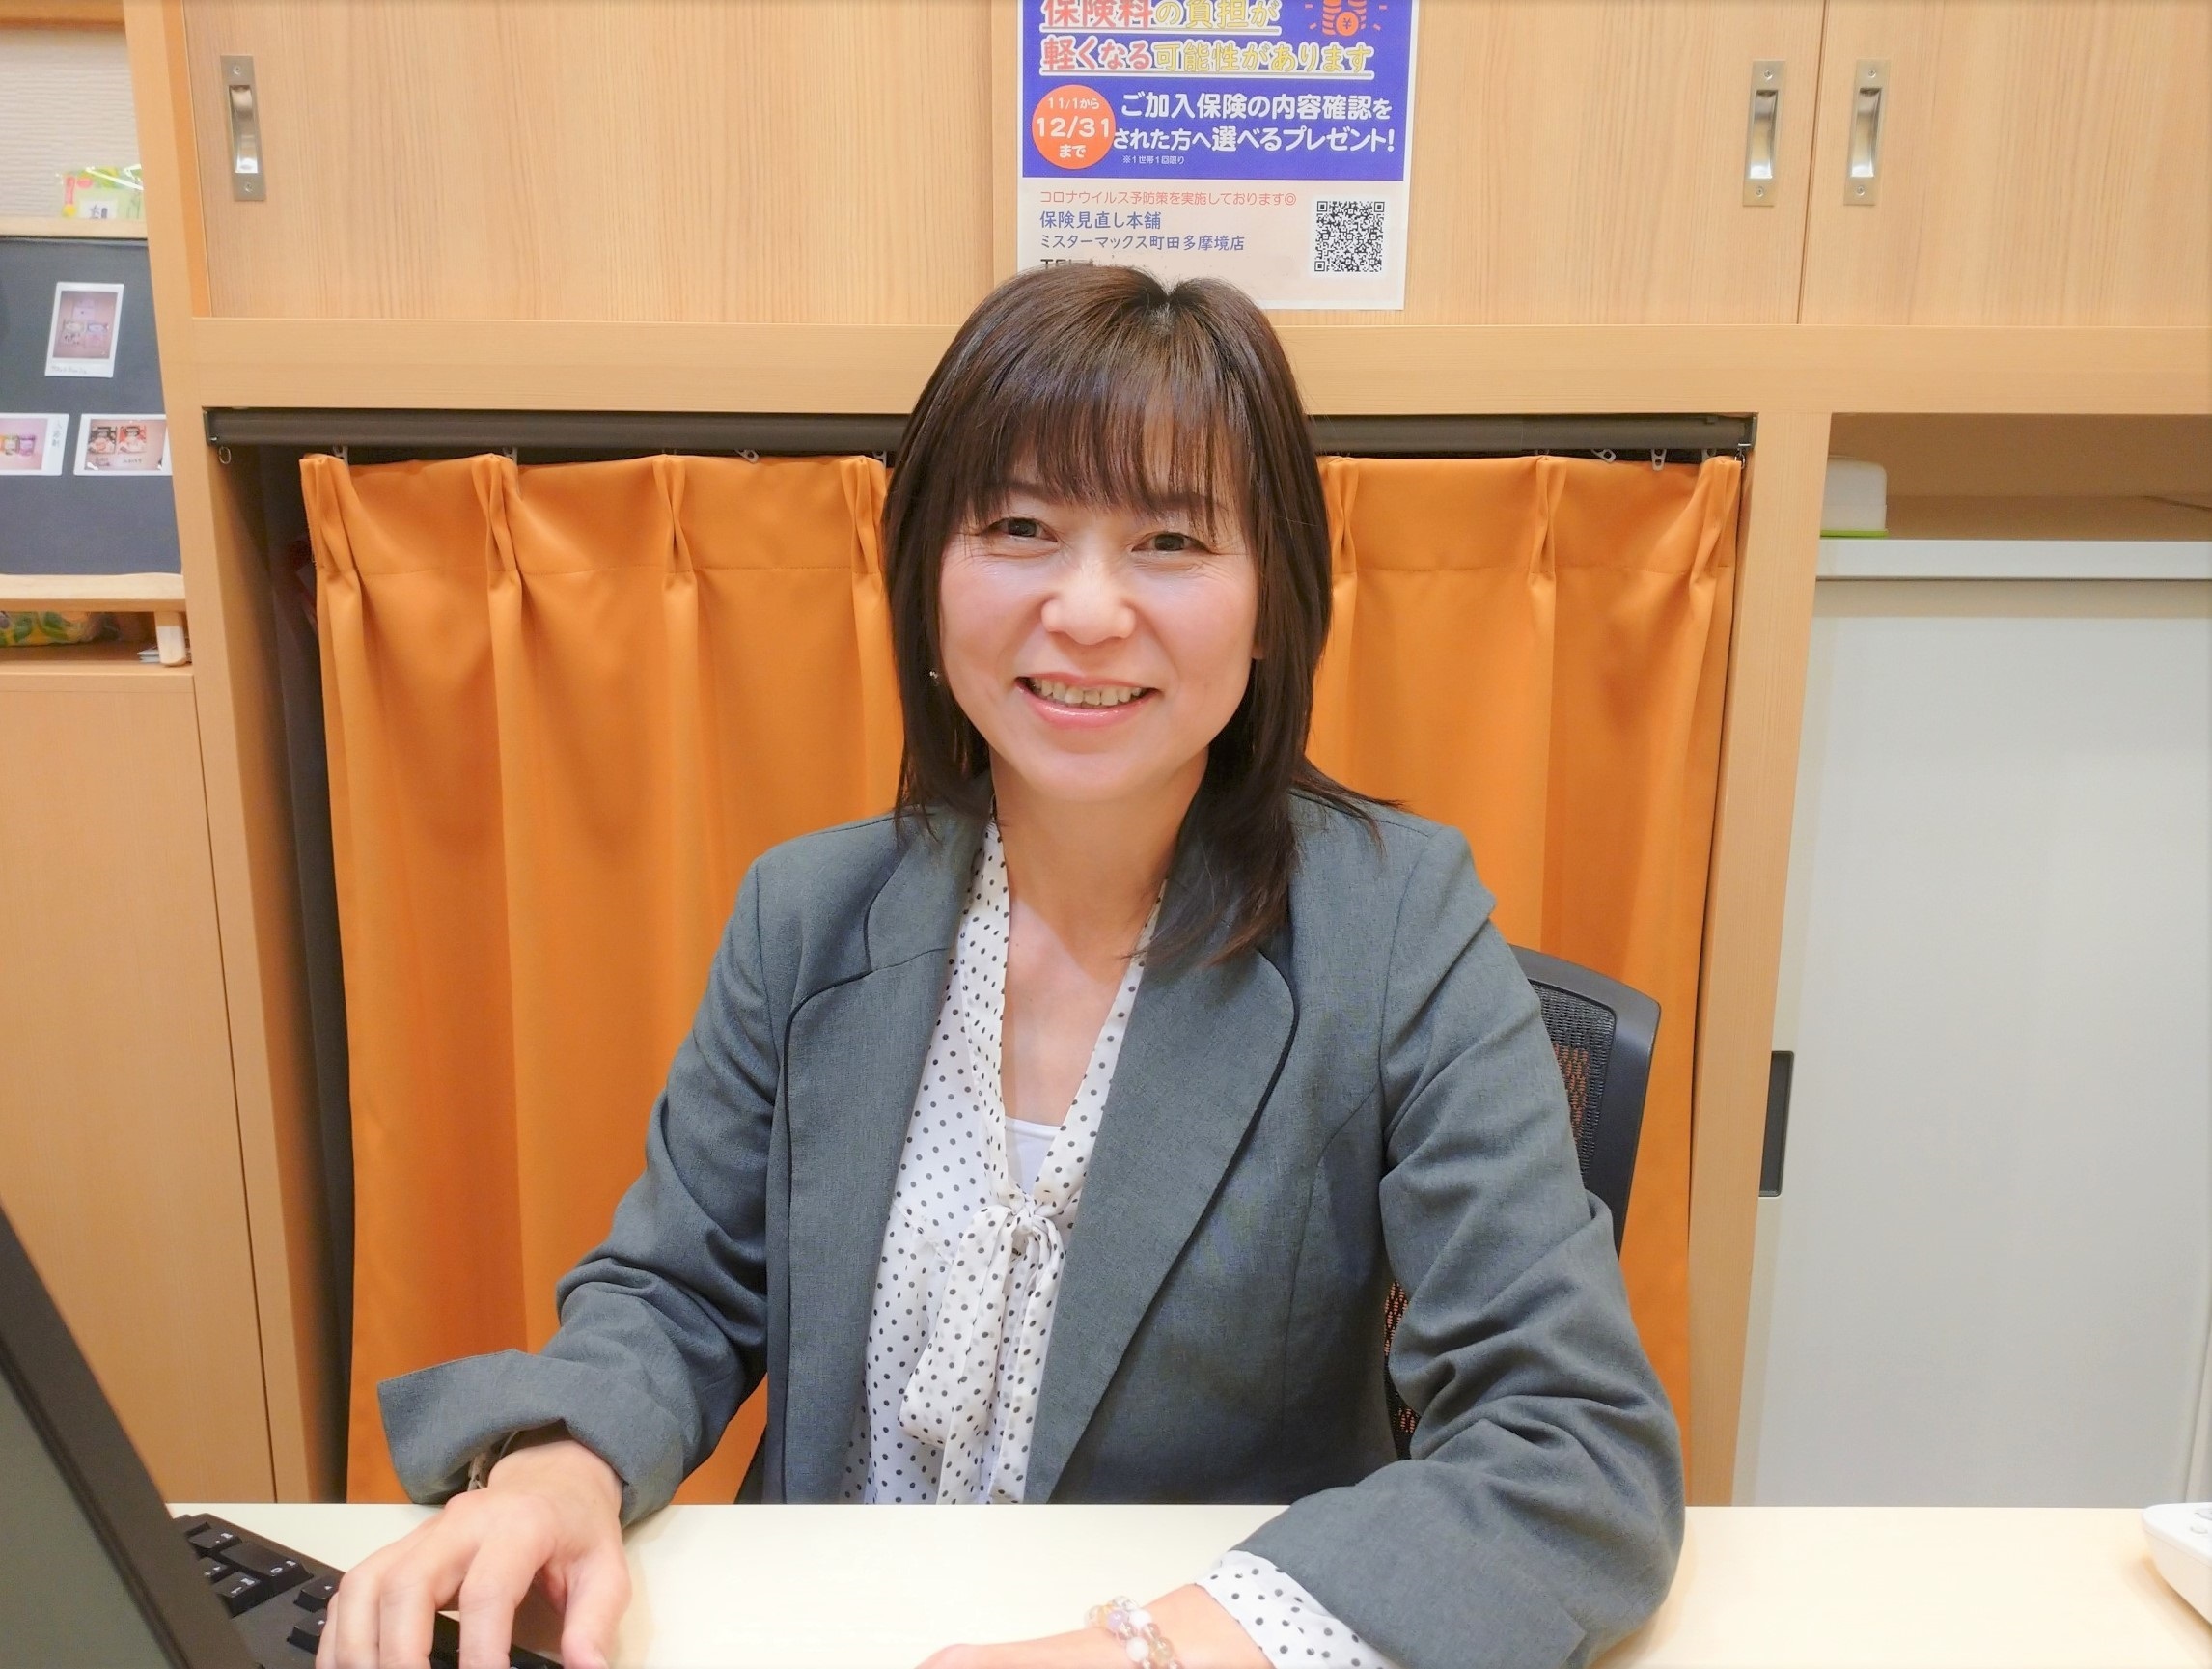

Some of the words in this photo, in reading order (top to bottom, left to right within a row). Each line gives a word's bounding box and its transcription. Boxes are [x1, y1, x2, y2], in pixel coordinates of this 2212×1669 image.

[1042, 37, 1373, 73] 軽くなる可能性があります
[1121, 91, 1393, 120] ご加入保険の内容確認を
[1037, 116, 1110, 139] 12/31
[1059, 144, 1087, 158] まで
[1039, 210, 1161, 230] 保険見直し本舗
[1040, 234, 1245, 252] ミスターマックス町田多摩境店
